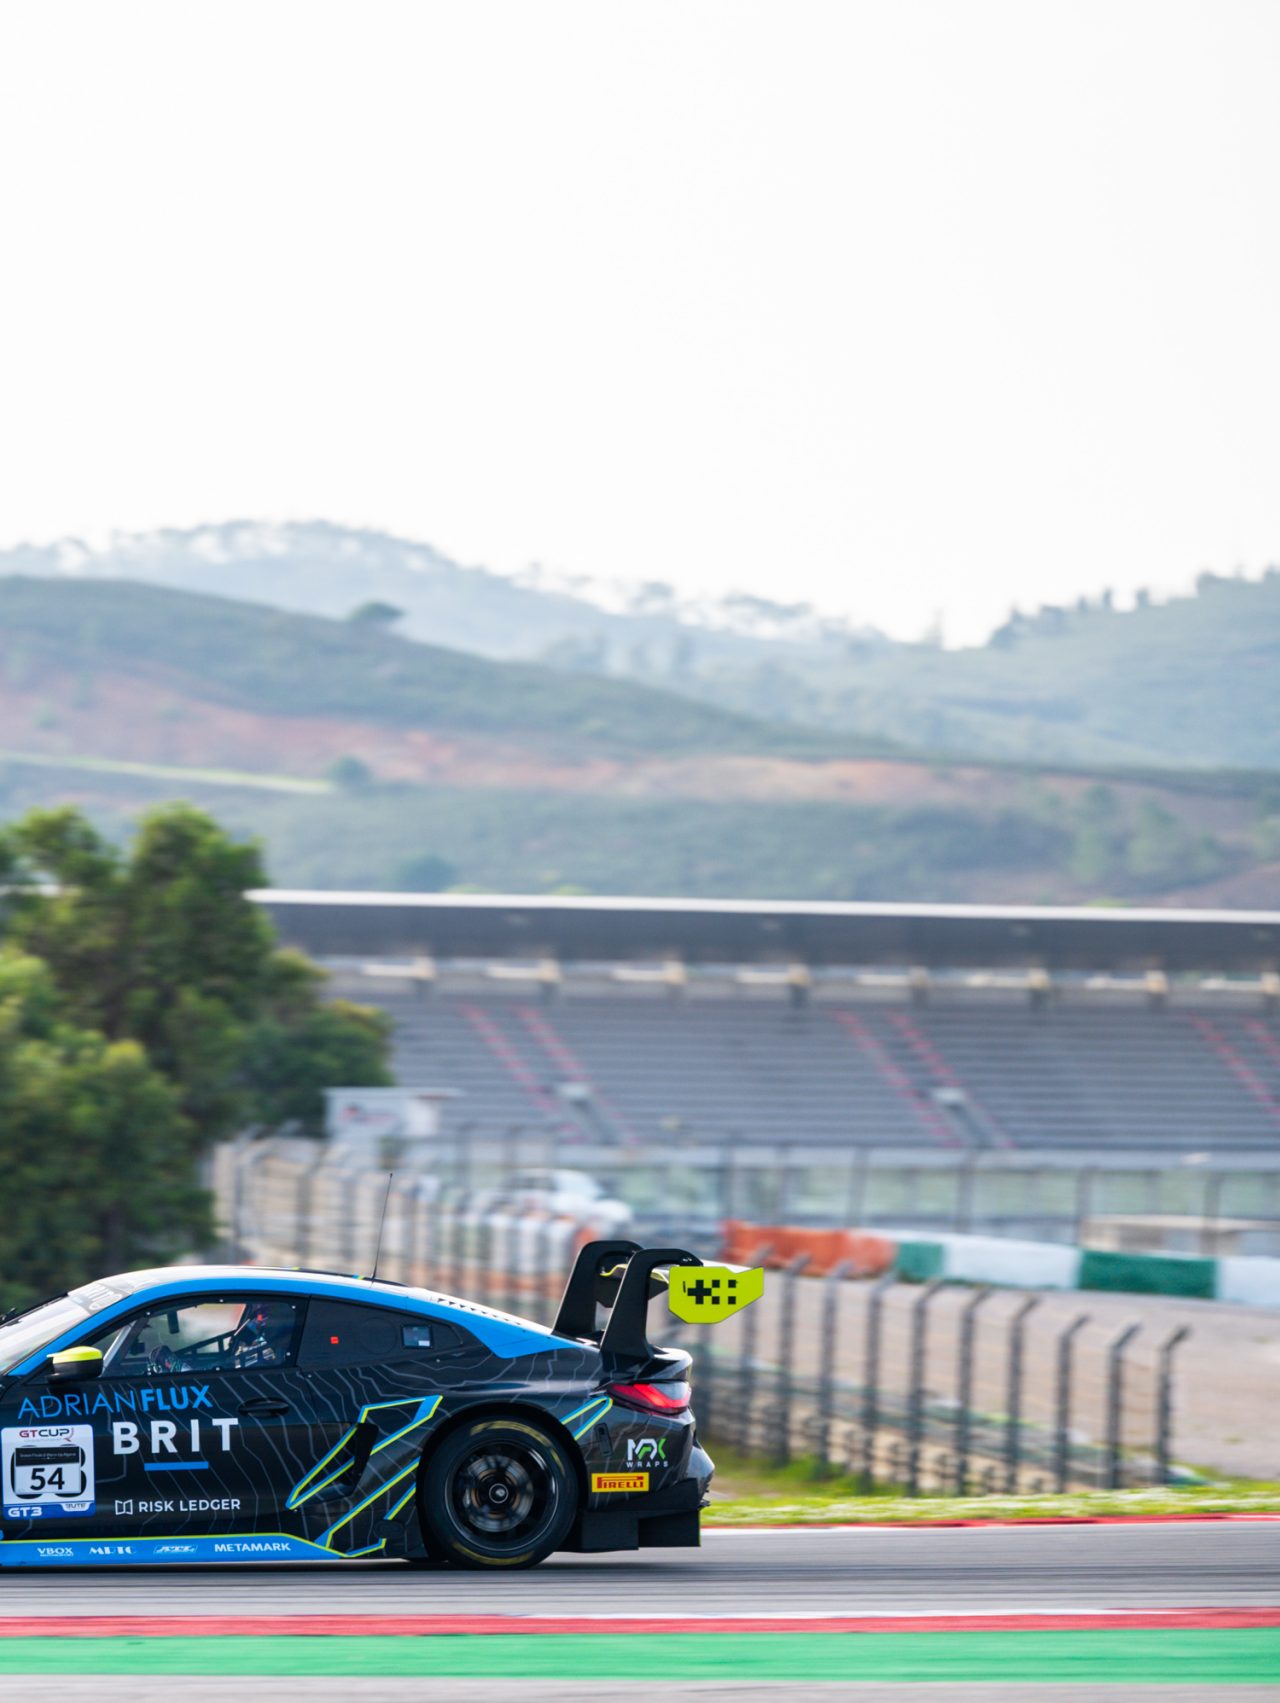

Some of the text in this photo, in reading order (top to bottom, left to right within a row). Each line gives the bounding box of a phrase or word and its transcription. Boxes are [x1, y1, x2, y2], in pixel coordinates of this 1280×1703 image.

[113, 1417, 239, 1455] BRIT
[30, 1467, 65, 1491] 54
[596, 1476, 644, 1489] PIRELLI
[8, 1507, 43, 1517] GT3
[139, 1499, 240, 1513] RISK LEDGER
[37, 1547, 73, 1555] VBOX
[214, 1543, 291, 1553] METAMARK
